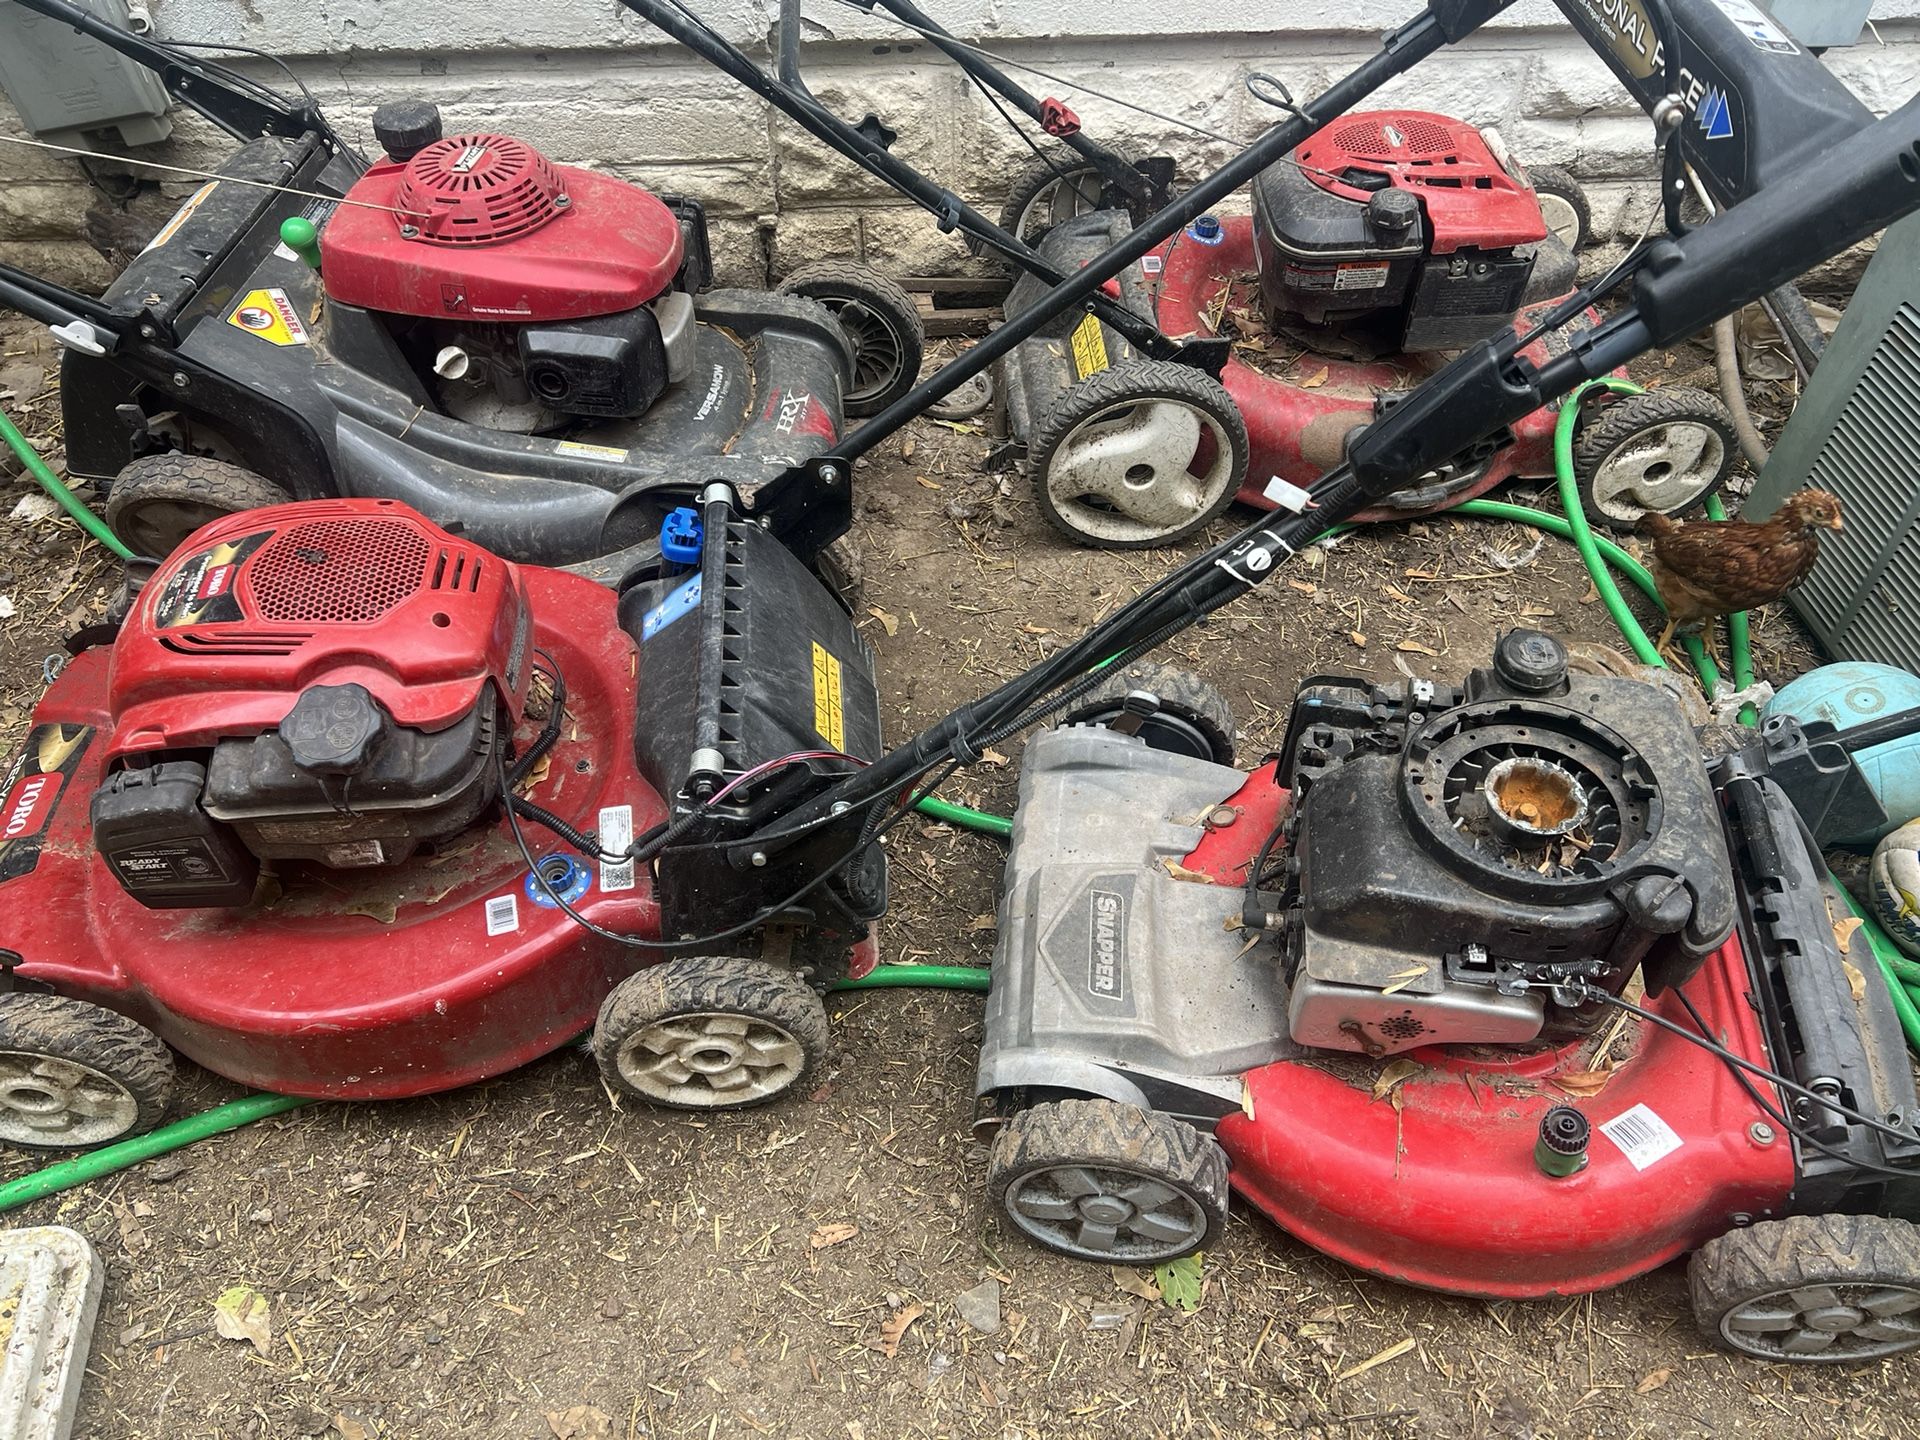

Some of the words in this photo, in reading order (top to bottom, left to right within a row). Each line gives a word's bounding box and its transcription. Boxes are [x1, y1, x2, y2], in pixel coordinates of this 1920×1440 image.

[1595, 0, 1647, 54] ONAL
[1651, 39, 1706, 112] PCE
[273, 297, 302, 335] DANGER
[693, 364, 724, 421] VERSAMOW
[776, 388, 810, 435] HRX
[207, 566, 229, 596] TORO
[6, 777, 47, 835] TORO
[120, 858, 161, 867] READY
[131, 863, 168, 871] START
[1095, 897, 1117, 991] SNAPPER
